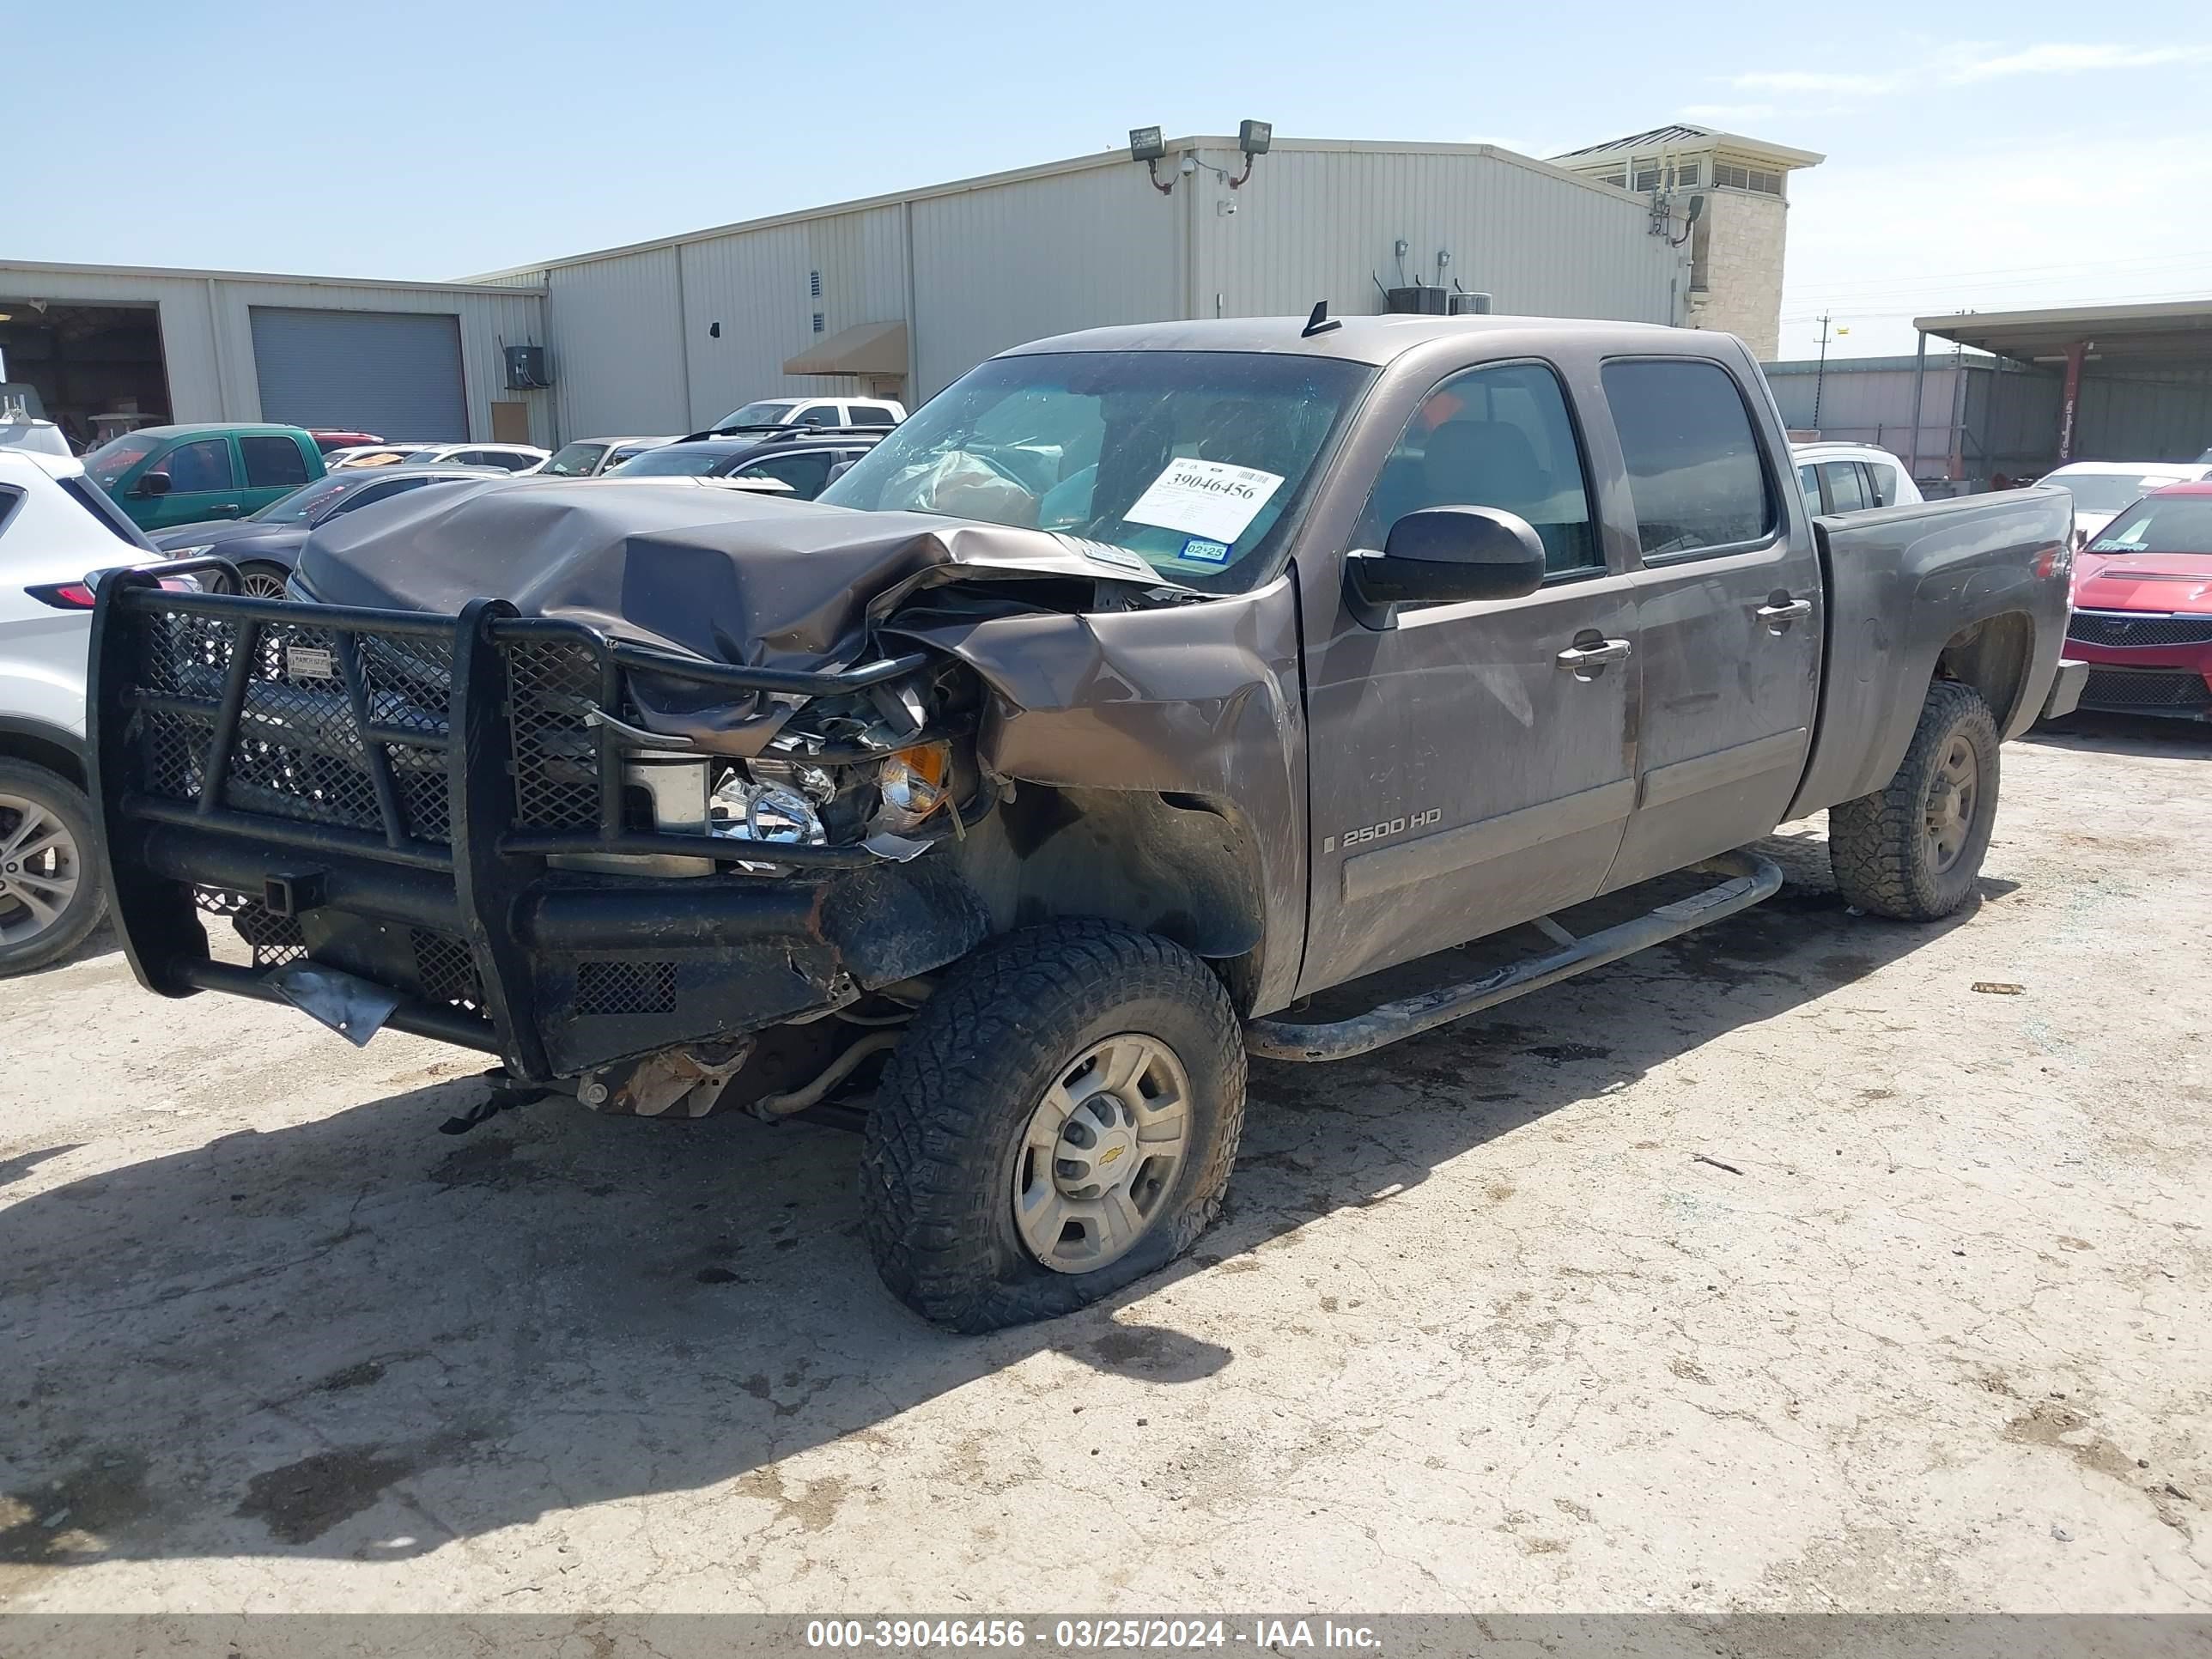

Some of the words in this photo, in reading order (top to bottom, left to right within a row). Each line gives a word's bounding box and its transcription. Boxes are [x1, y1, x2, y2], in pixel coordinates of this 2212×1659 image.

[1167, 473, 1258, 500] 39046456
[1342, 817, 1406, 847] 2500
[1410, 808, 1442, 829] HD
